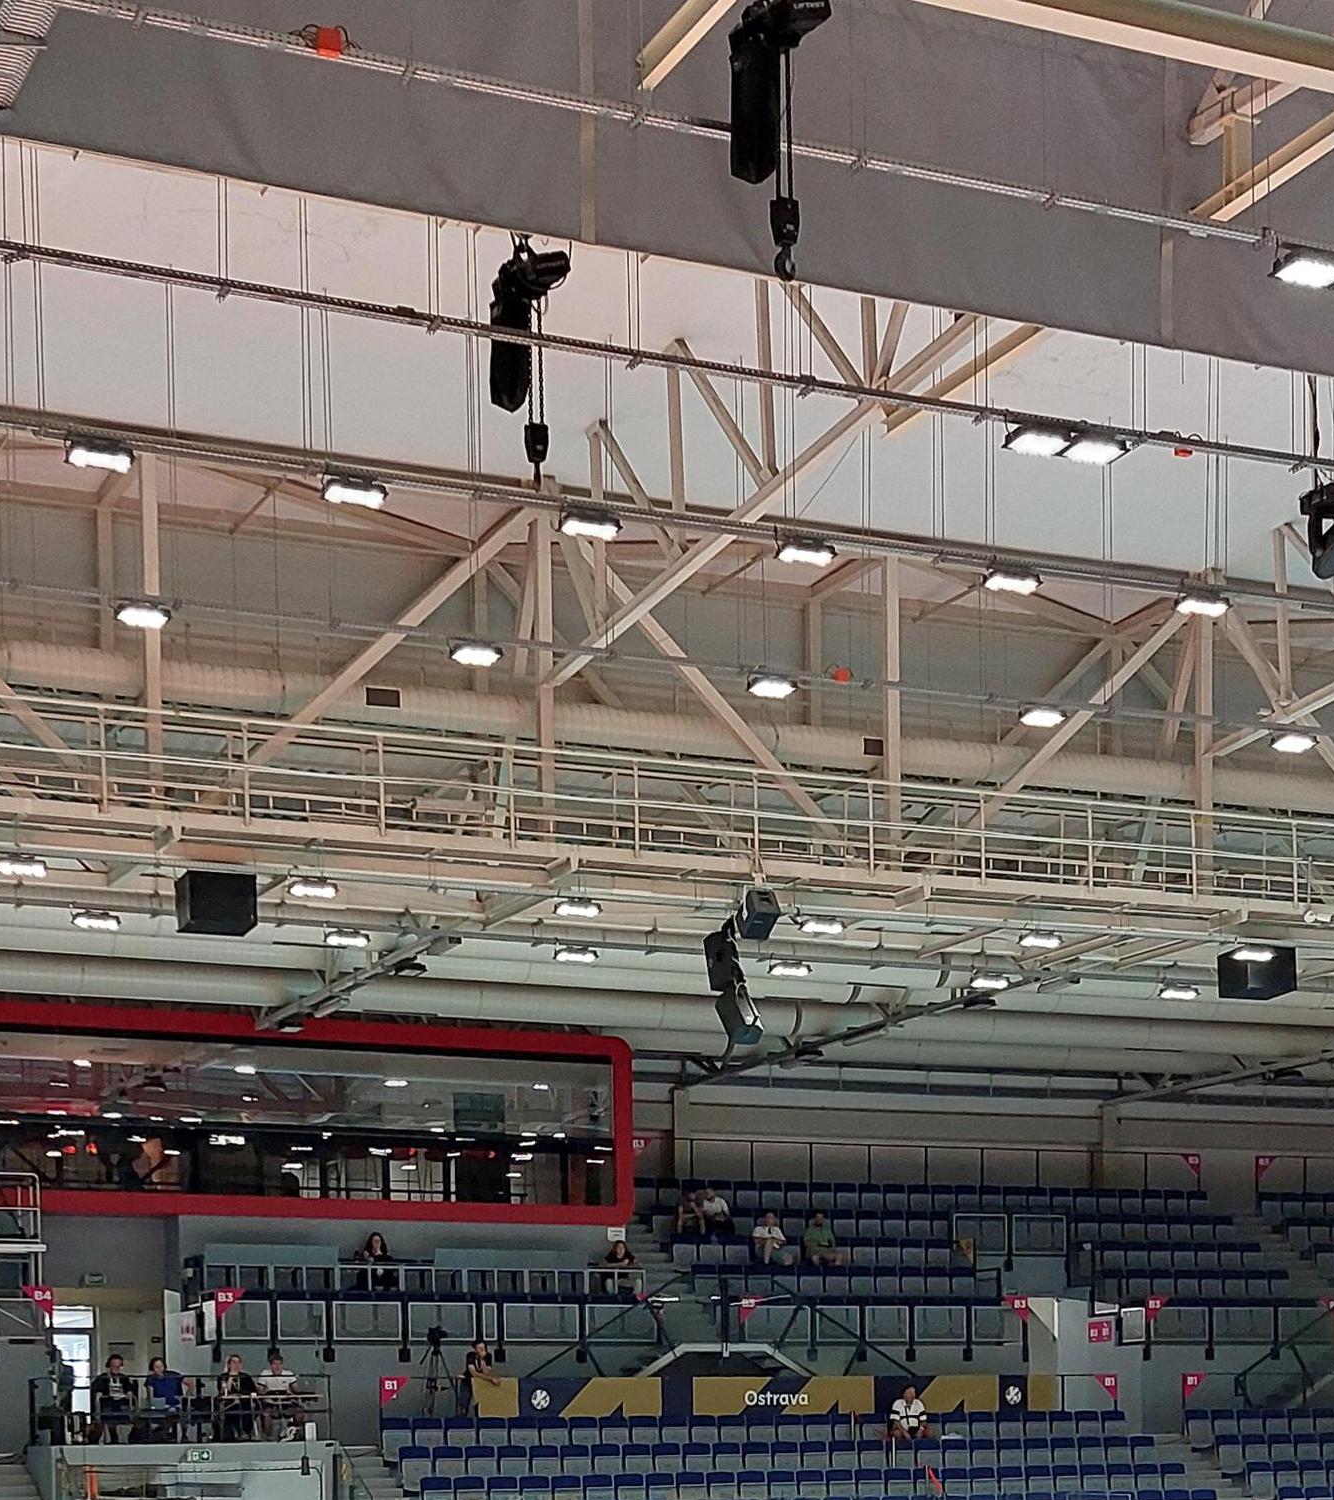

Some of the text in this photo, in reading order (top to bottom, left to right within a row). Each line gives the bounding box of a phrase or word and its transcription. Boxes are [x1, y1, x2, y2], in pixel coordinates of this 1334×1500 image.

[33, 1290, 51, 1301] B4
[217, 1292, 234, 1302] B3
[384, 1380, 398, 1391] B1
[744, 1390, 809, 1406] Ostrava
